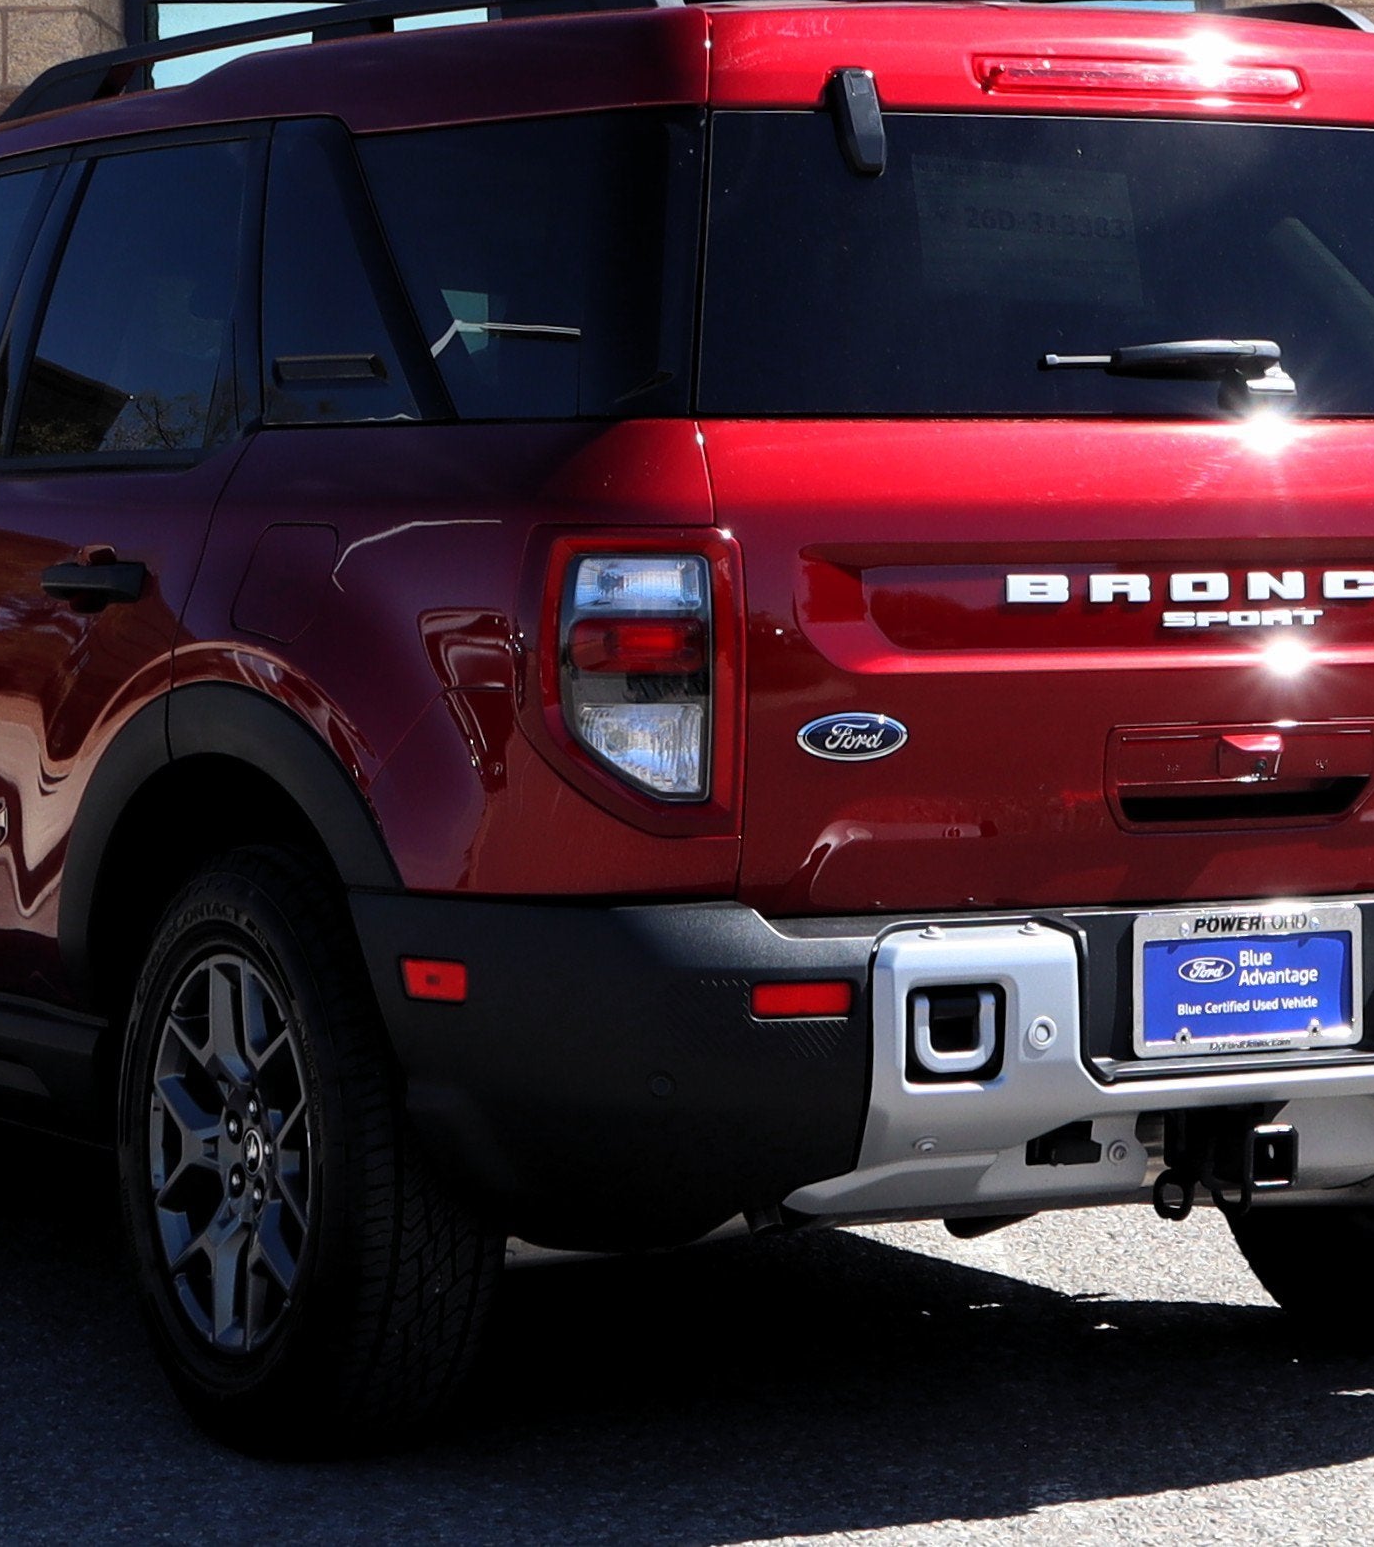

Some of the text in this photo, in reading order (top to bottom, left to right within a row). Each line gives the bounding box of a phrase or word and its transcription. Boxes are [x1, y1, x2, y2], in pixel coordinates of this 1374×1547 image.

[1162, 608, 1324, 628] SPORT
[823, 722, 885, 750] Ford
[1238, 949, 1272, 967] Blue
[1188, 960, 1224, 980] Ford
[1238, 966, 1319, 987] Advantage
[1177, 996, 1318, 1016] Blue Certified Used Vehicle
